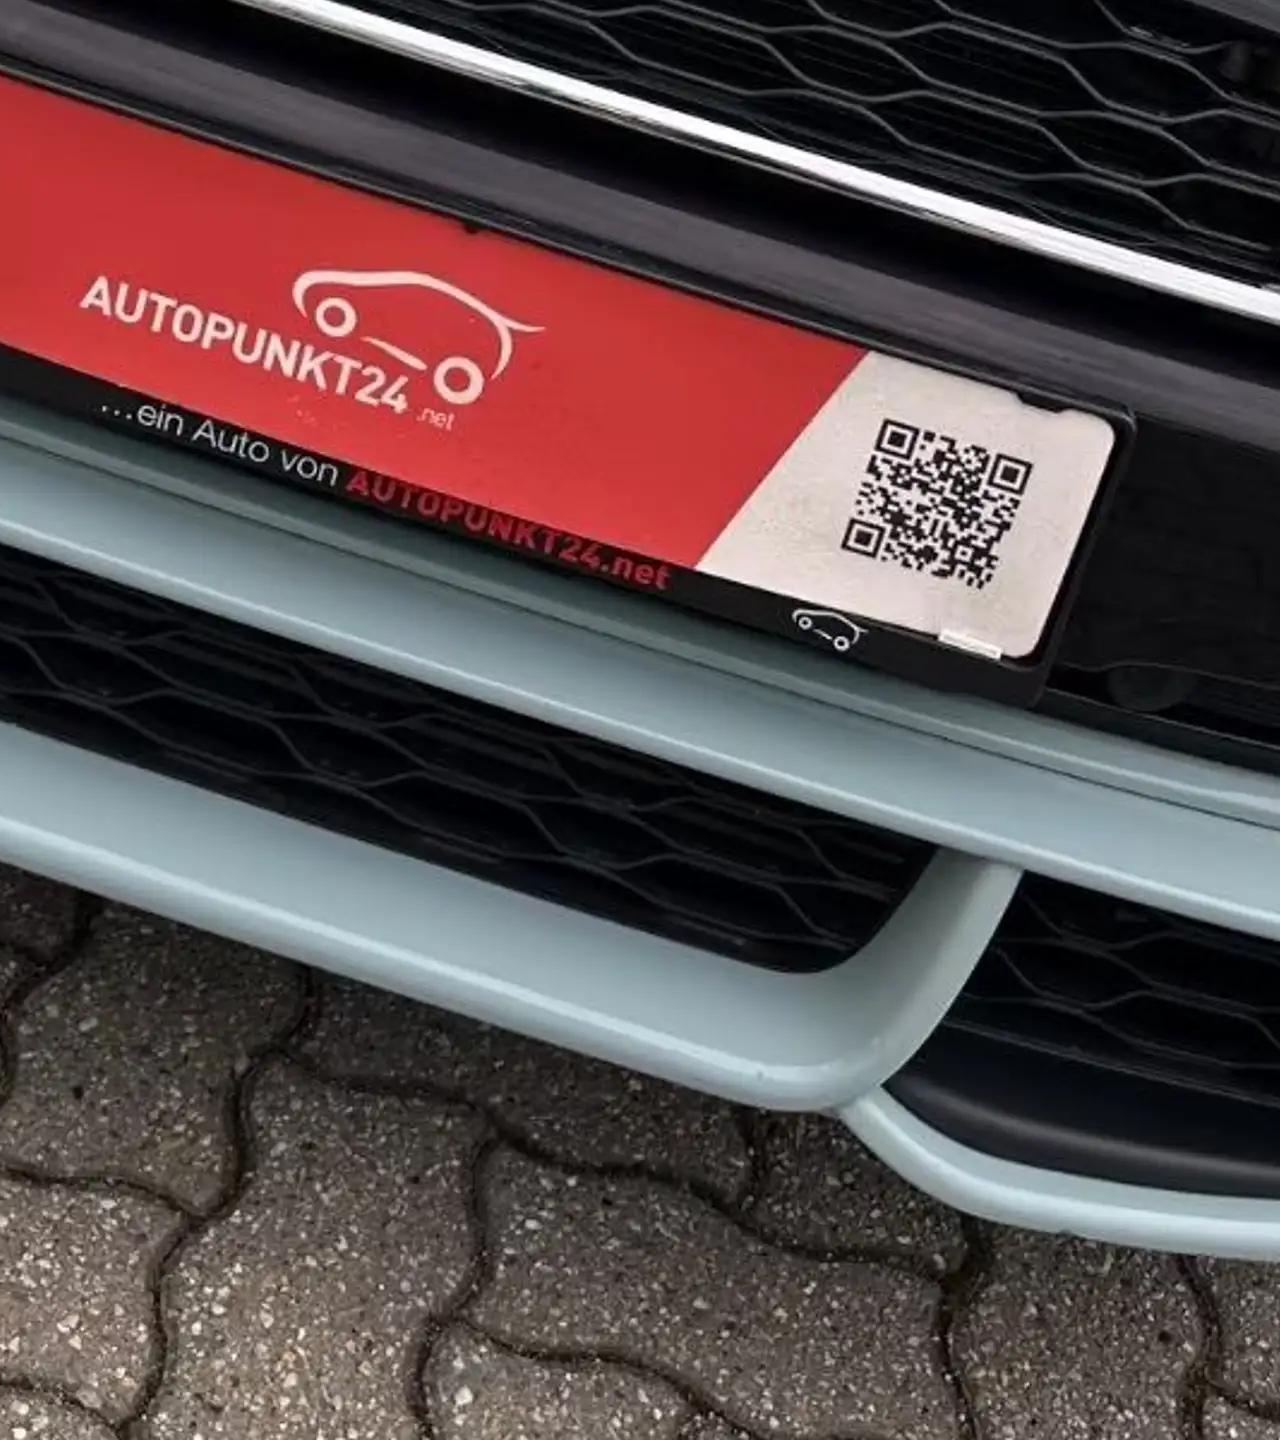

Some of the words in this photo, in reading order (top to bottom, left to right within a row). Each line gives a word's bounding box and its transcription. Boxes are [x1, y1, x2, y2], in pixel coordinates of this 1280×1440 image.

[80, 276, 409, 414] AUTOPUNKT24
[192, 419, 270, 463] Auto
[278, 449, 339, 488] von
